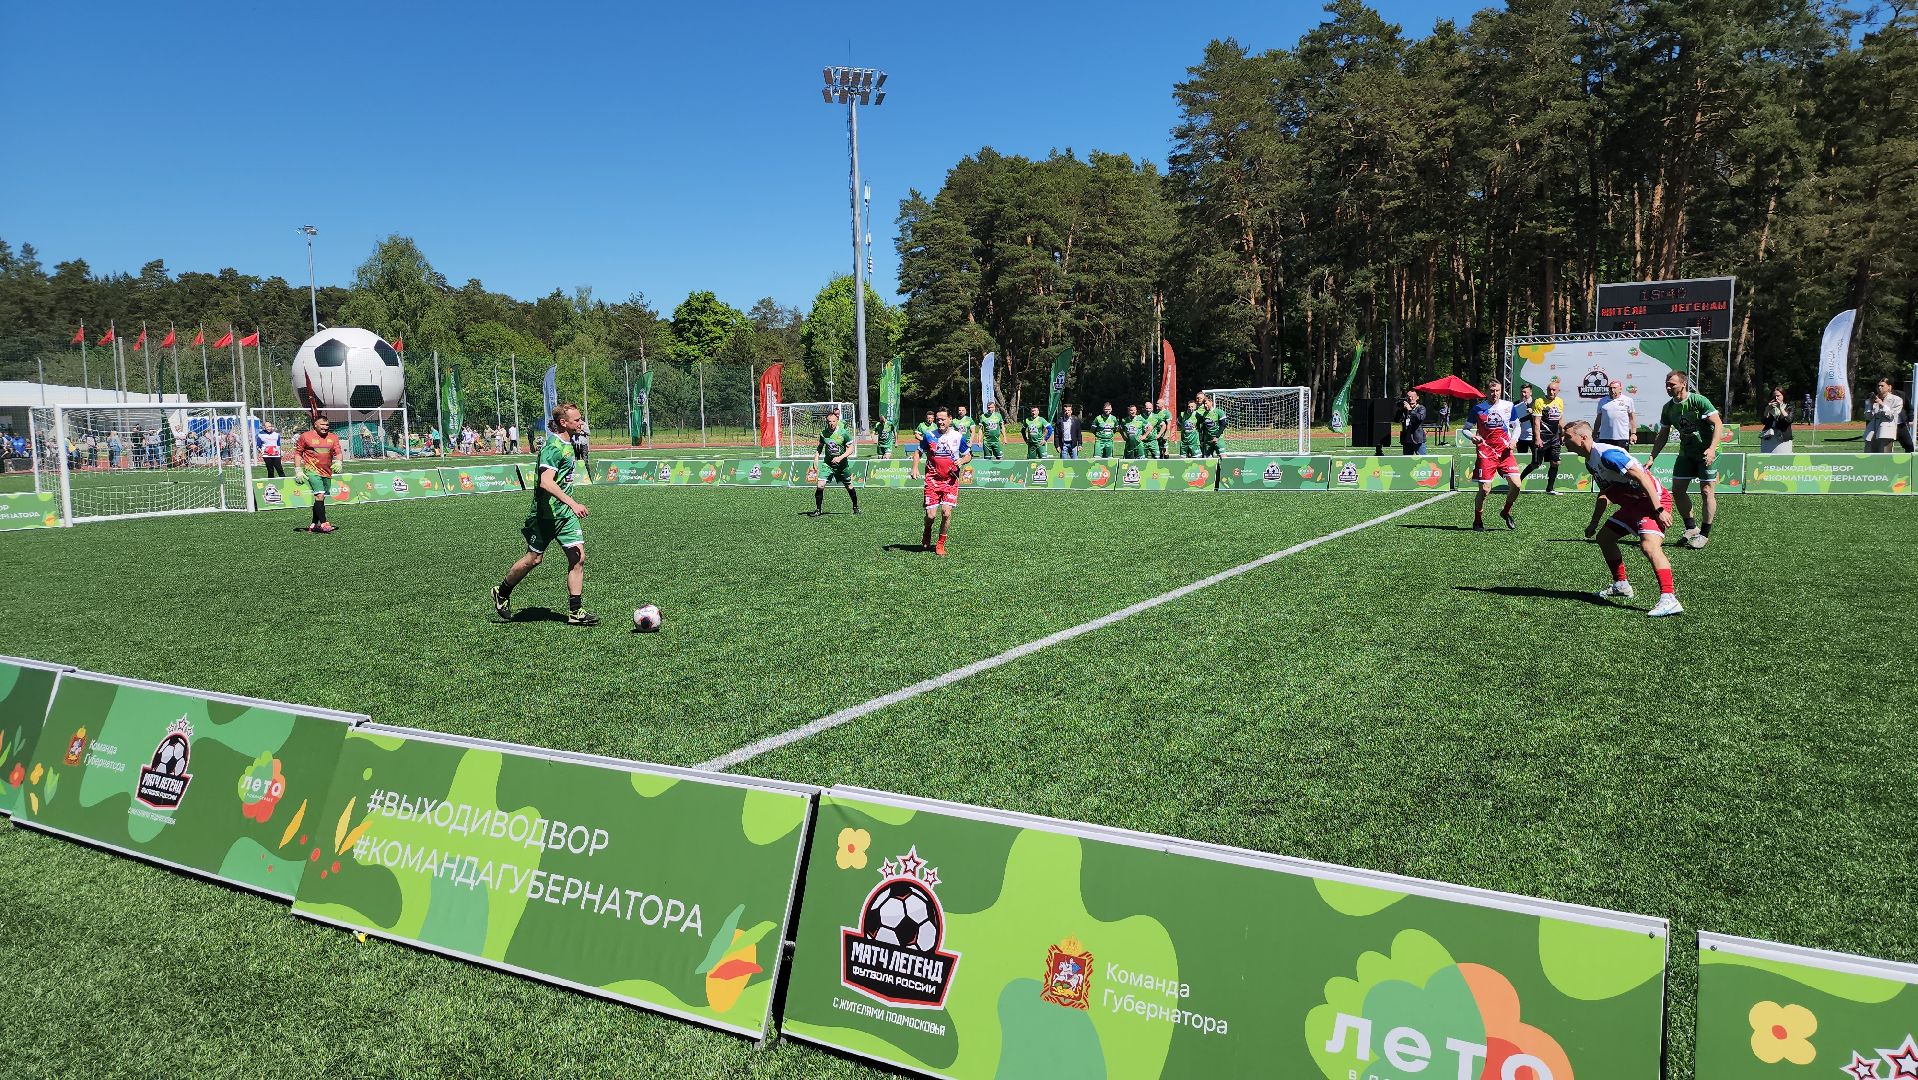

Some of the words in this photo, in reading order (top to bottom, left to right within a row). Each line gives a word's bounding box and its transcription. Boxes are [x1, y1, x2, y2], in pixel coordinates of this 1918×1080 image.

[1670, 301, 1727, 313] ЛЕГЕНДЫ
[89, 739, 118, 756] Команда
[366, 788, 610, 857] #ВЫХОДИВОДВОР
[353, 835, 703, 938] #КОМАНДАГУБЕРНАТОРА
[851, 942, 889, 969] МАТЧ
[888, 950, 944, 984] ЛЕГЕНД
[852, 965, 895, 985] ФУТБОЛА
[895, 978, 937, 995] РОССИИ
[1106, 962, 1190, 998] Команда
[832, 997, 840, 1008] С
[840, 998, 885, 1020] ЖИТЕЛЯМИ
[885, 1010, 946, 1036] ПОДМОСКОВЬЯ
[1103, 988, 1228, 1035] Губернатора
